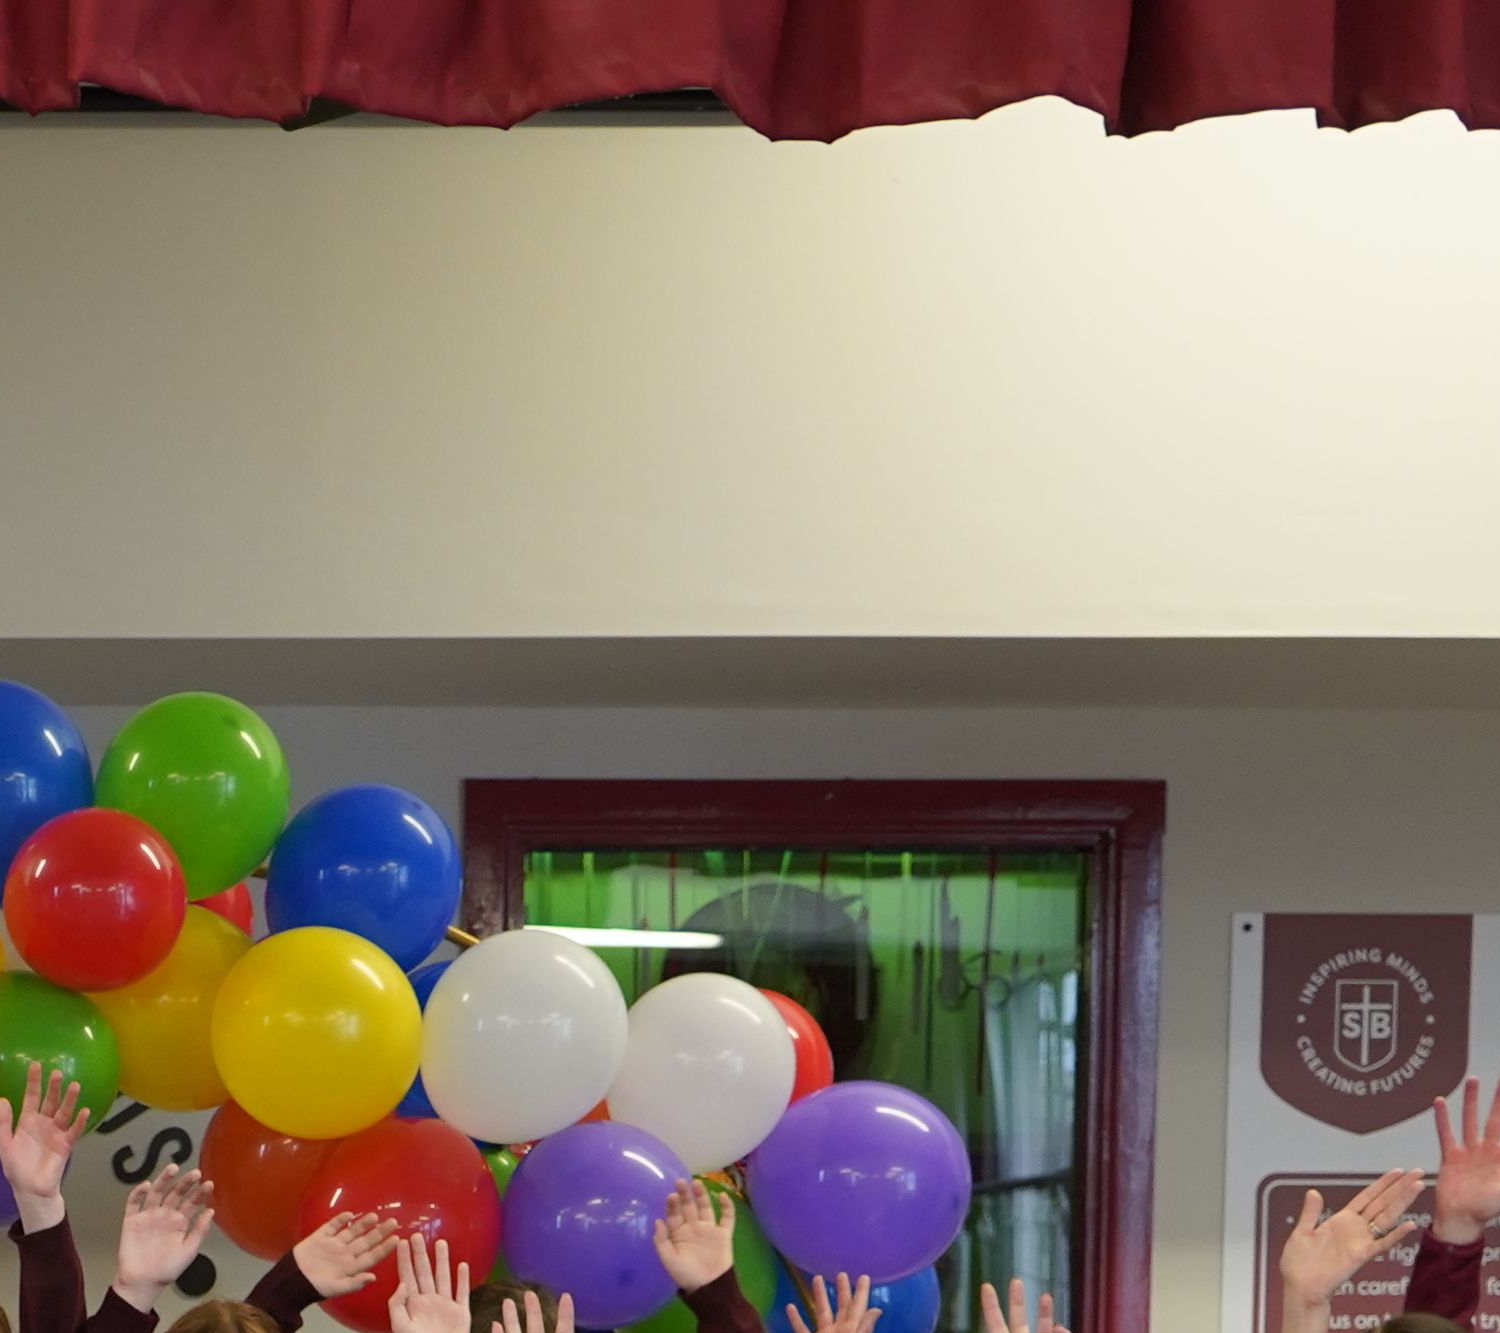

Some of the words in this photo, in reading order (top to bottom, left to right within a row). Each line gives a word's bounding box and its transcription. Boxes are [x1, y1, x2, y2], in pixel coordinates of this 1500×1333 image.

[1298, 947, 1384, 1004] INSPIRING
[1384, 952, 1435, 1004] MINDS
[1297, 1035, 1368, 1096] CREATING
[1370, 1034, 1435, 1096] FUTURES
